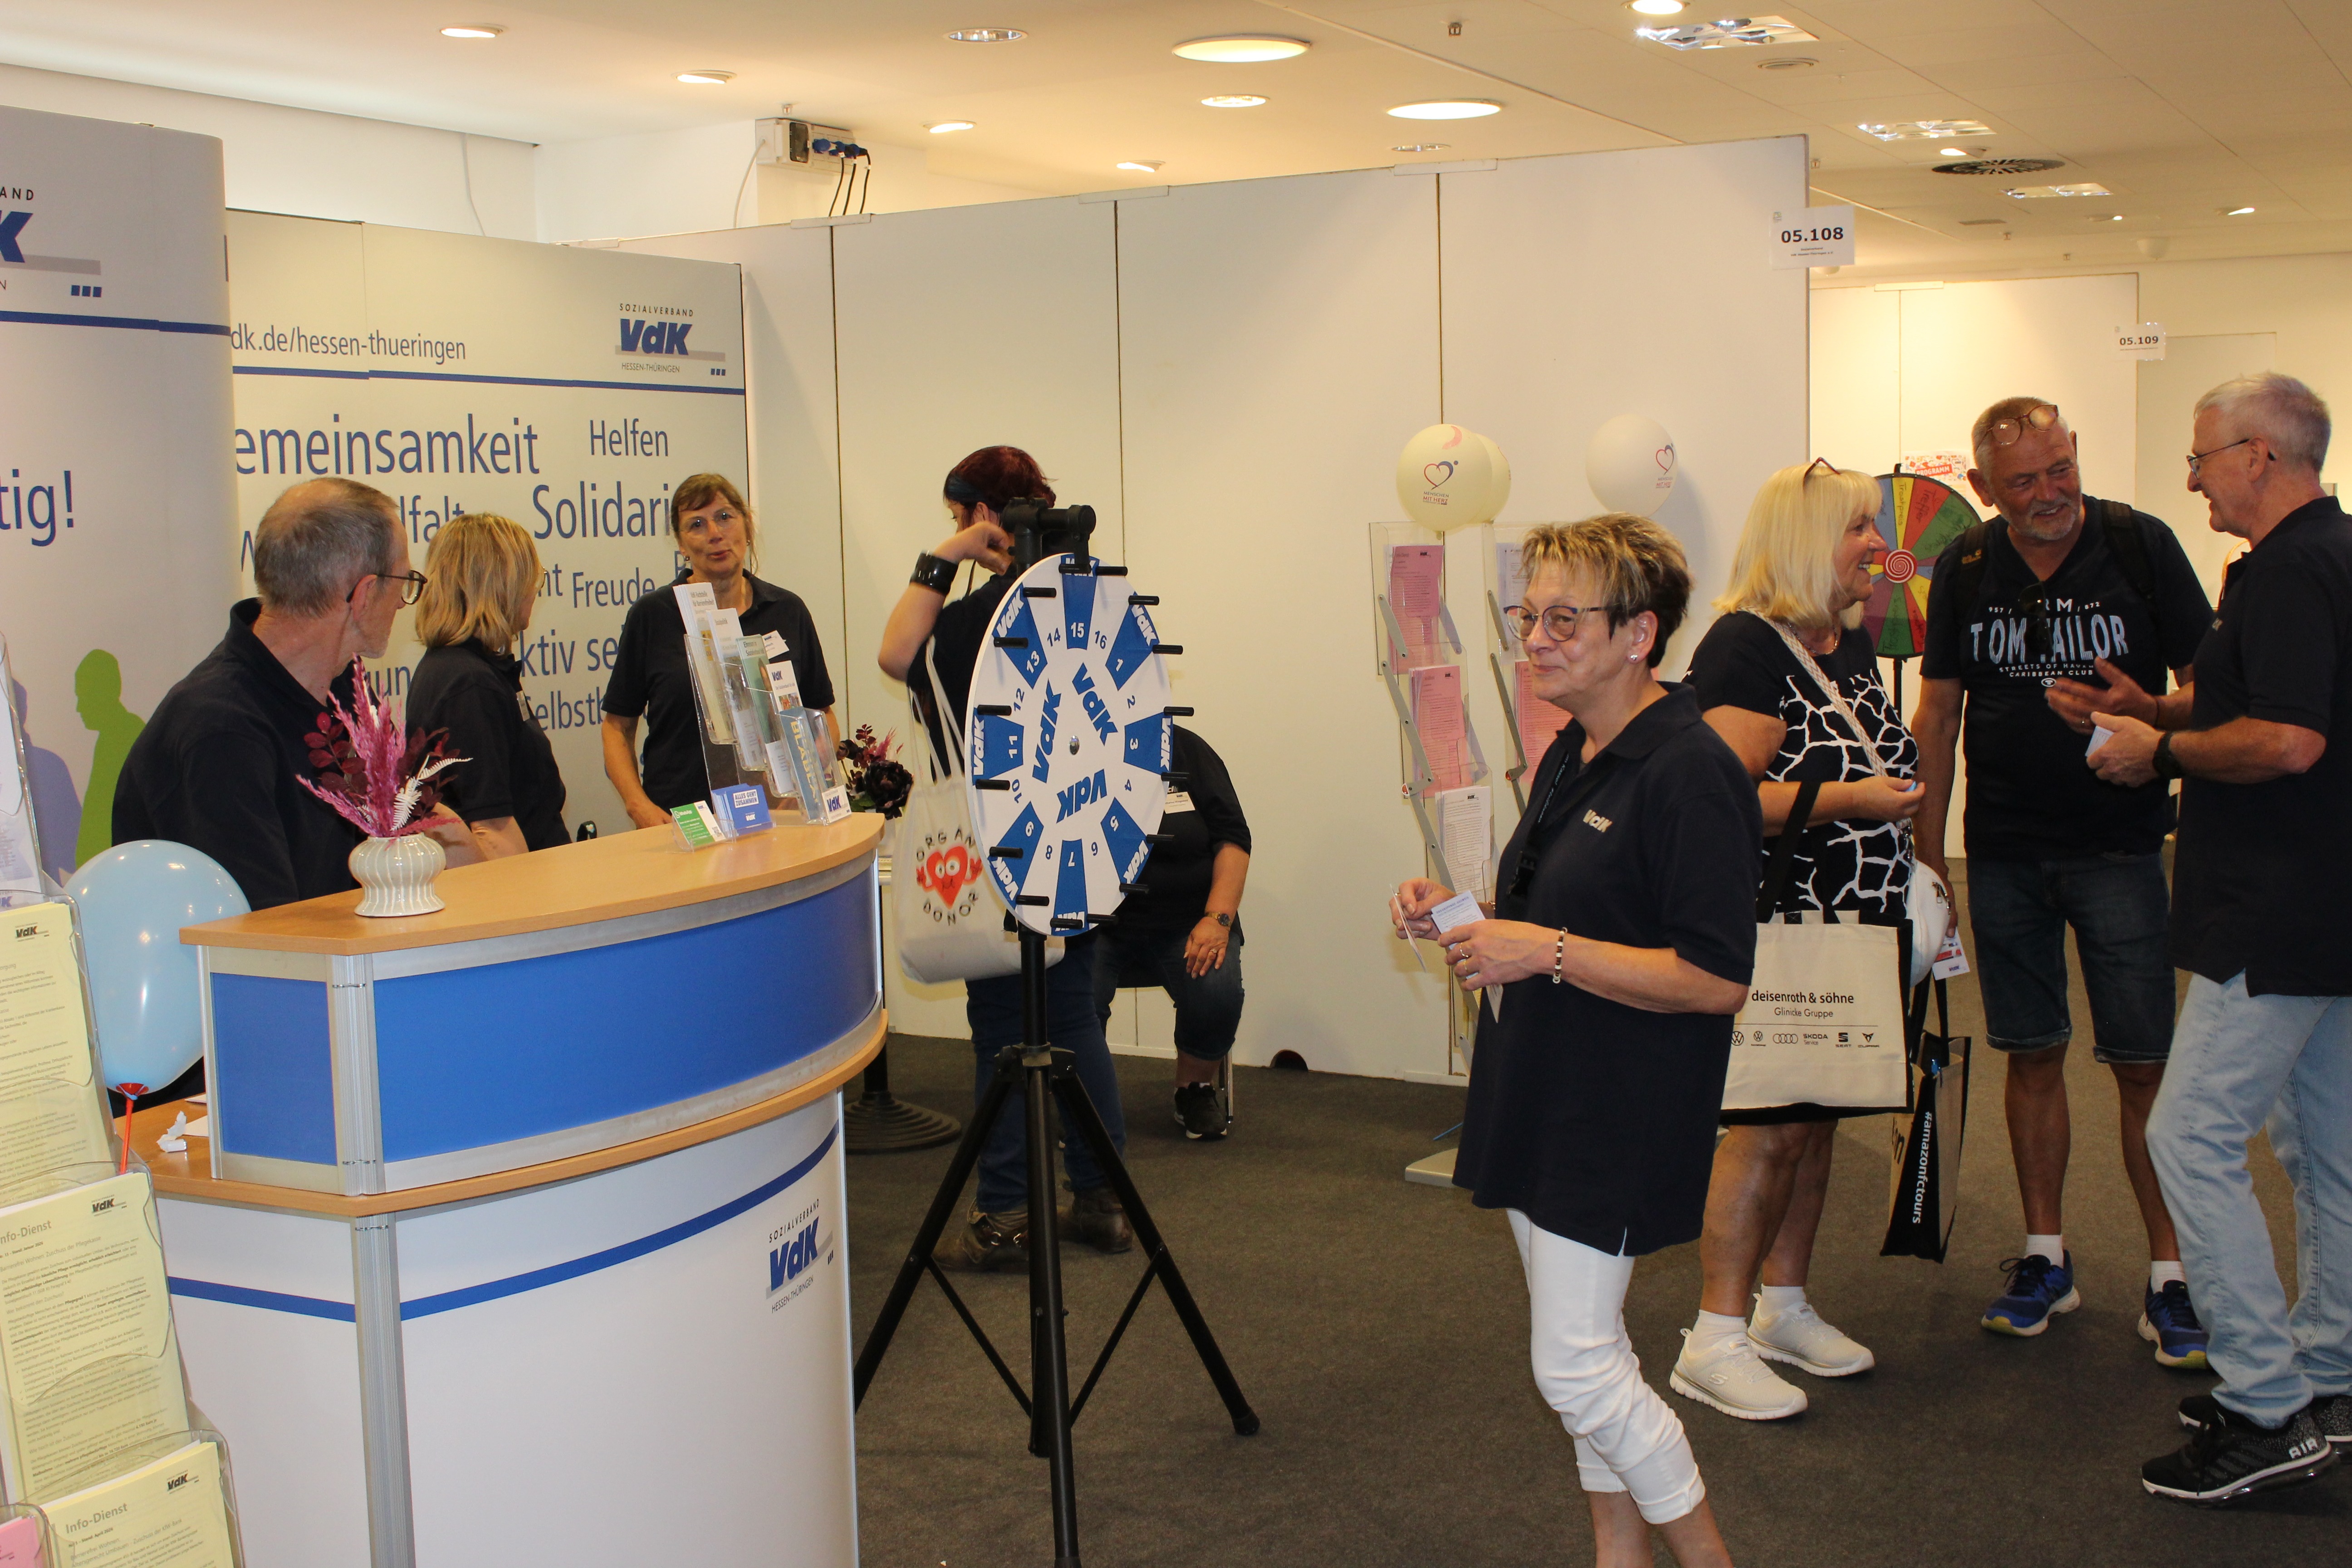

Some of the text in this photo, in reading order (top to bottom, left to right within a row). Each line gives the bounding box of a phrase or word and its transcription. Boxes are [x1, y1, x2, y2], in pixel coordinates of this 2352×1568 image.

[1781, 227, 1843, 243] 05.108
[620, 303, 693, 317] SOZIALVERBAND
[230, 323, 466, 365] dk.de/hessen-thueringen
[620, 318, 692, 355] VdK
[2120, 336, 2159, 345] 05.109
[622, 363, 680, 372] HESSEN-THÜRINGEN
[235, 413, 539, 475] emeinsamkeit
[590, 418, 668, 457] Helfen
[1916, 466, 1950, 475] PROGRAMM
[533, 480, 670, 539] Solidari
[573, 568, 655, 608] Freude
[995, 588, 1024, 638] VdK
[1047, 627, 1061, 647] 14
[1071, 622, 1085, 638] 15
[1131, 604, 1157, 647] VdK
[1095, 630, 1107, 649] 16
[1971, 614, 2129, 664] TOM AILOR
[520, 629, 575, 677] ktiv
[1026, 649, 1040, 674] 13
[772, 670, 783, 681] VdK
[1116, 659, 1124, 672] 1
[1999, 664, 2040, 672] STREETS
[1014, 687, 1025, 713] 12
[1072, 662, 1117, 746] VdK
[1127, 695, 1136, 709] 2
[1032, 678, 1062, 784] VdK
[972, 714, 985, 776] VdK
[1009, 734, 1018, 759] 11
[1130, 737, 1139, 750] 3
[1160, 717, 1173, 771] VdK
[1012, 778, 1022, 804] 10
[1056, 768, 1107, 823] VdK
[1124, 778, 1132, 792] 4
[735, 797, 757, 806] ZUSAMMEN
[827, 795, 841, 813] VdK
[1110, 815, 1119, 832] 5
[1583, 809, 1612, 833] VdK
[916, 828, 975, 862] ORGAN
[1045, 845, 1052, 860] 8
[1068, 851, 1075, 867] 7
[1123, 839, 1149, 884] VdK
[991, 857, 1019, 901] VdK
[923, 892, 978, 926] DONOR
[16, 926, 38, 938] VdK
[1752, 990, 1854, 1004] deisenroth & söhne
[1774, 1007, 1833, 1019] Glinicke Gruppe
[1913, 1111, 1932, 1224] #amazonfctours
[92, 1197, 115, 1213] VdK
[0, 1220, 52, 1244] nfo-Dienst
[769, 1199, 819, 1243] SOZIALVERBAND
[45, 1247, 66, 1256] Zuschuss
[75, 1236, 101, 1248] Pflegekasse
[770, 1215, 819, 1292] VdK
[772, 1275, 813, 1313] HESSEN-THÜRINGEN
[2289, 1438, 2319, 1459] AIR
[167, 1473, 188, 1490] VdK
[66, 1502, 129, 1534] Info-Dienst
[132, 1531, 154, 1543] Zuschuss
